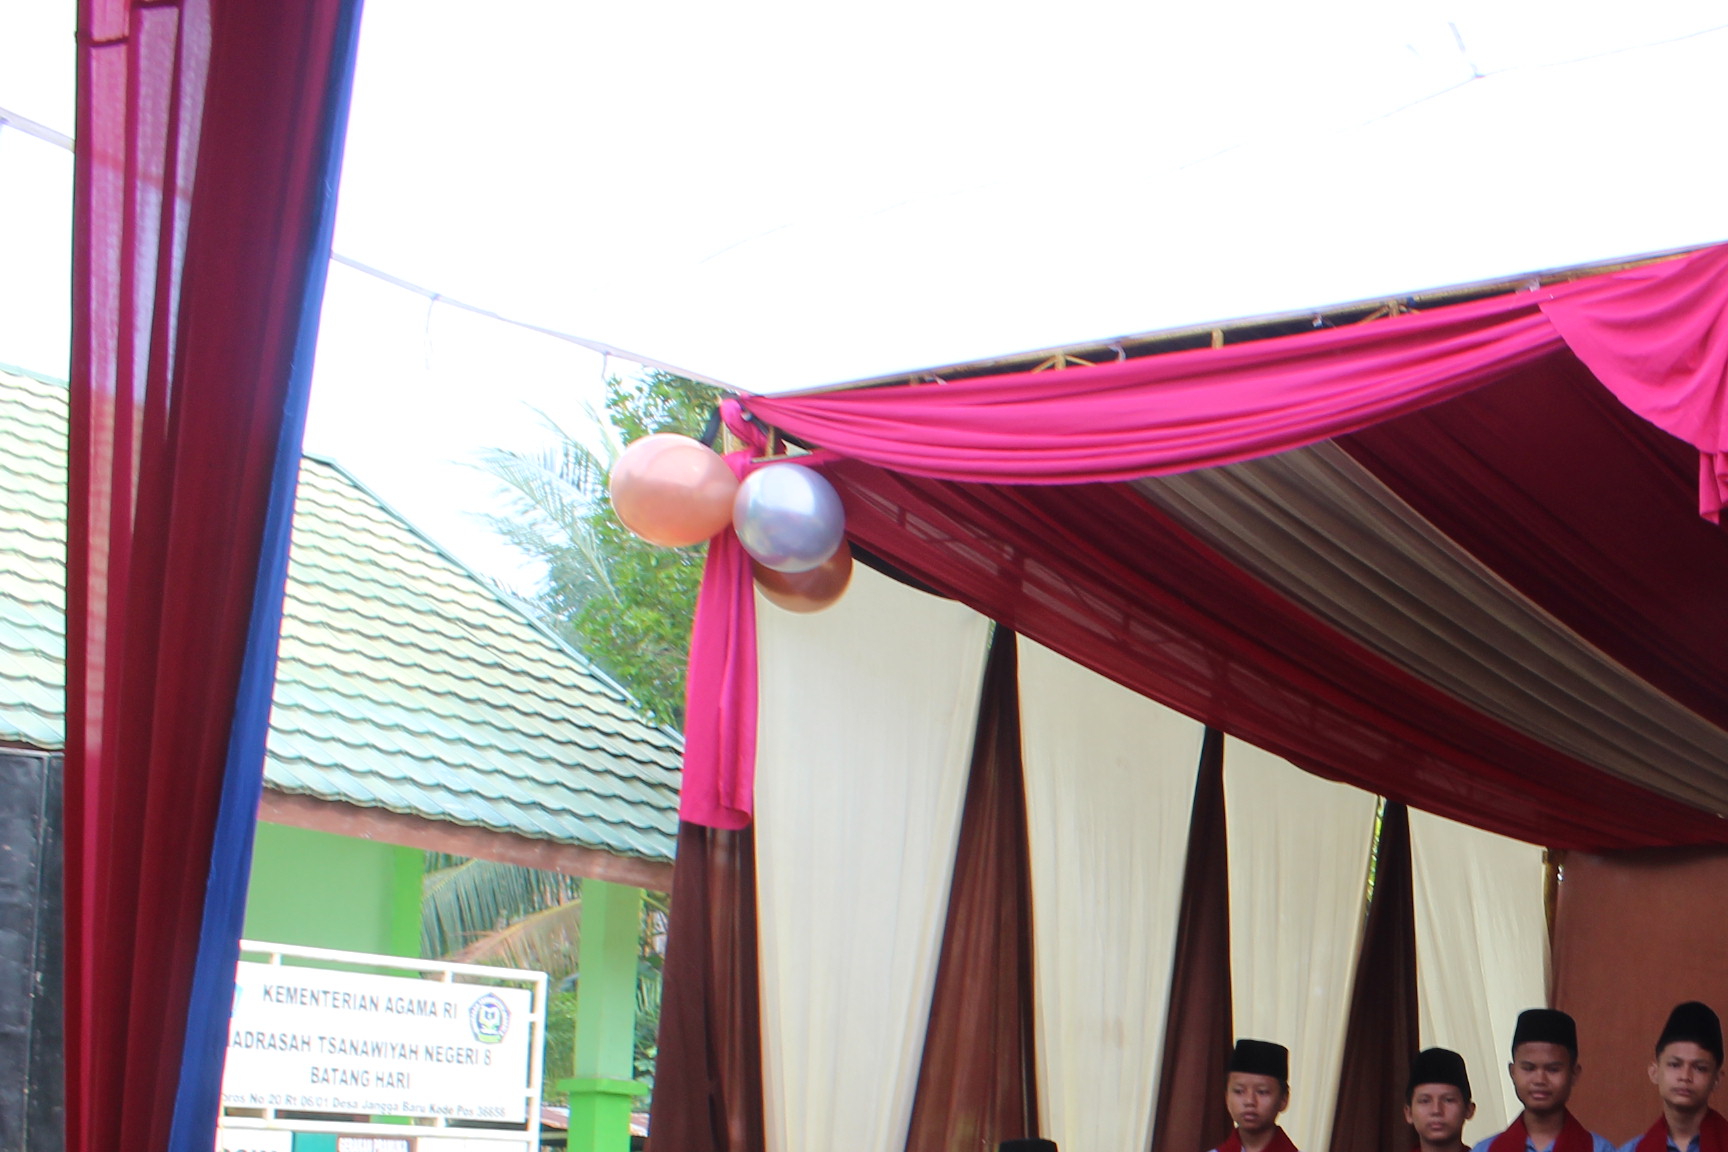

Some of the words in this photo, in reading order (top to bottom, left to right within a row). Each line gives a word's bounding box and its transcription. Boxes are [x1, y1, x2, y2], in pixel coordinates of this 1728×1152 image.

[263, 984, 379, 1013] KEMENTERIAN
[384, 996, 438, 1018] AGAMA
[443, 1001, 457, 1020] RI
[229, 1030, 311, 1053] ADRASAH
[318, 1035, 419, 1061] TSANAWIYAH
[424, 1045, 479, 1066] NEGERI
[484, 1048, 492, 1066] 8
[311, 1066, 370, 1087] BATANG
[375, 1071, 411, 1090] HARI
[332, 1096, 359, 1109] Desa
[429, 1102, 455, 1116] Kode
[456, 1105, 475, 1117] Pos
